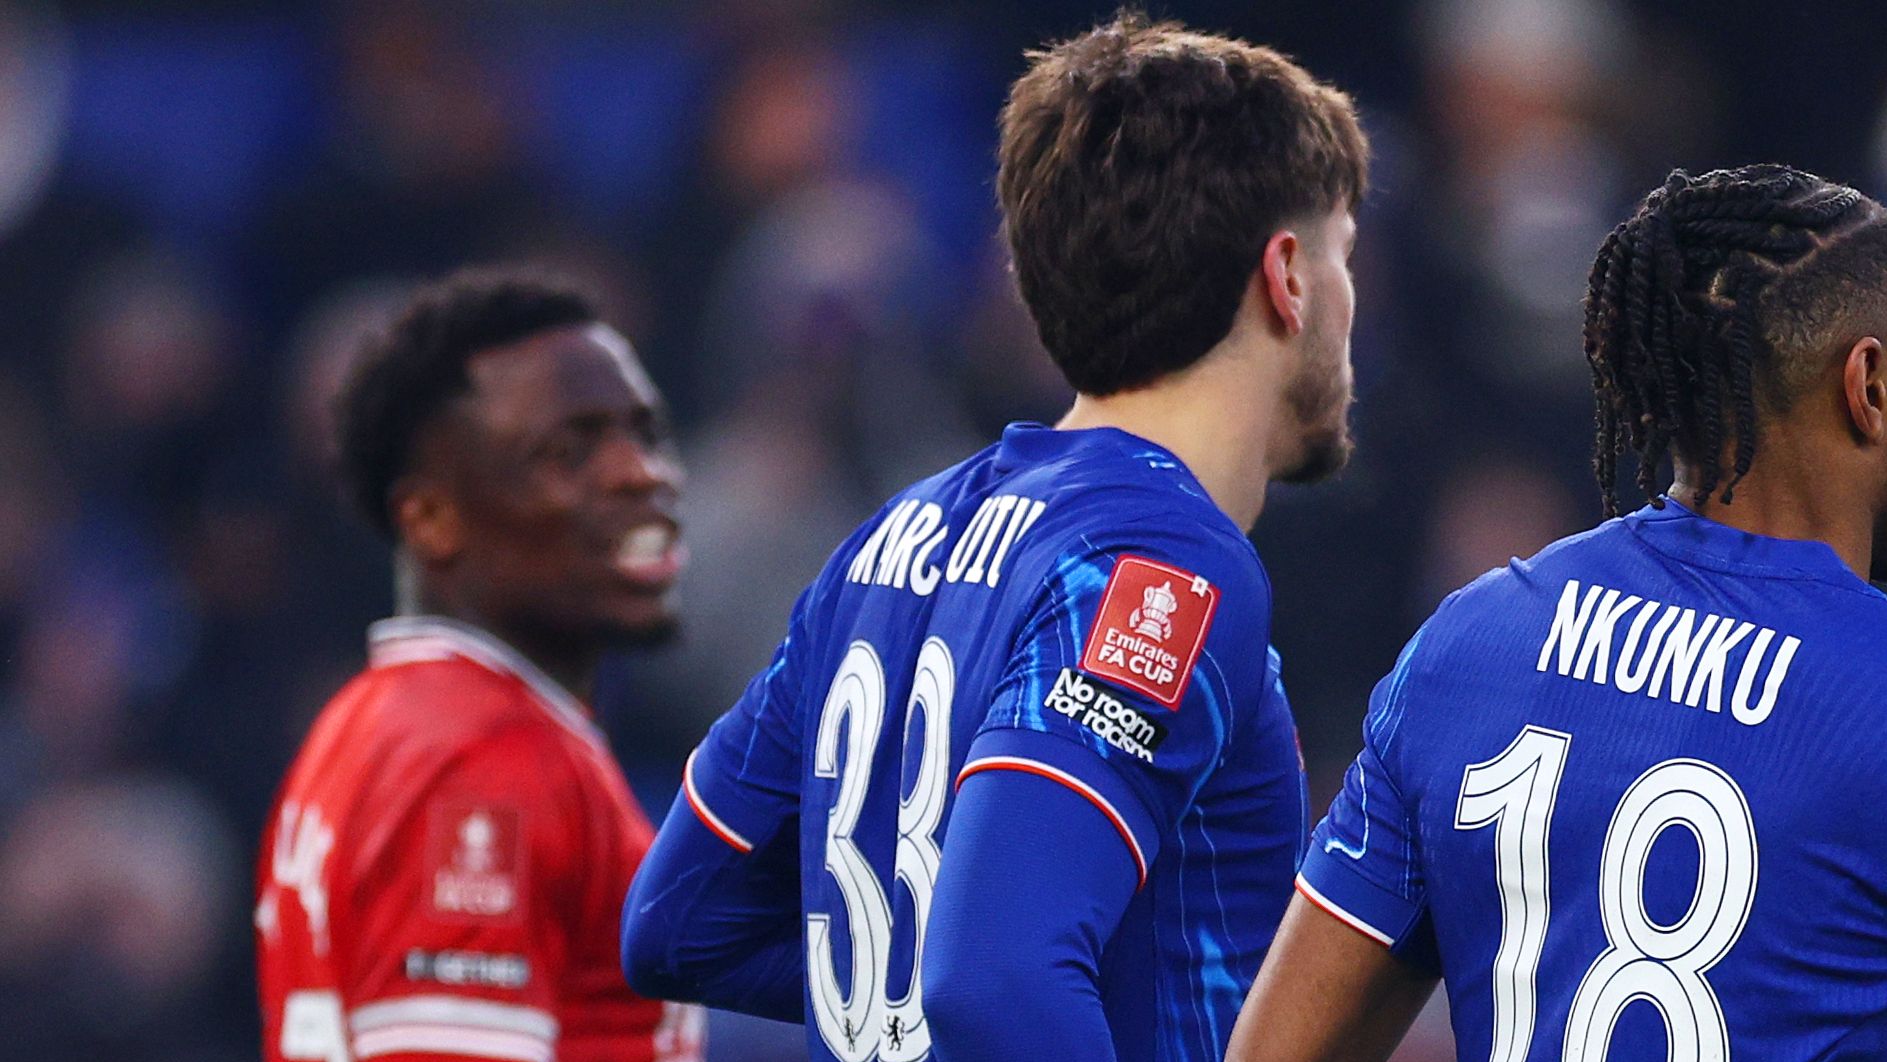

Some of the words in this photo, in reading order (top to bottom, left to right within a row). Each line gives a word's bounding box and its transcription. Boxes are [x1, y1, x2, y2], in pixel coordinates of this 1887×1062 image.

[1098, 644, 1125, 668] FA
[1128, 654, 1175, 685] CUP
[1104, 627, 1178, 670] Emirates
[1536, 579, 1800, 726] NKUNKU
[1043, 688, 1086, 718] for
[1081, 709, 1154, 764] racism
[1052, 667, 1095, 703] No
[1093, 692, 1156, 745] room
